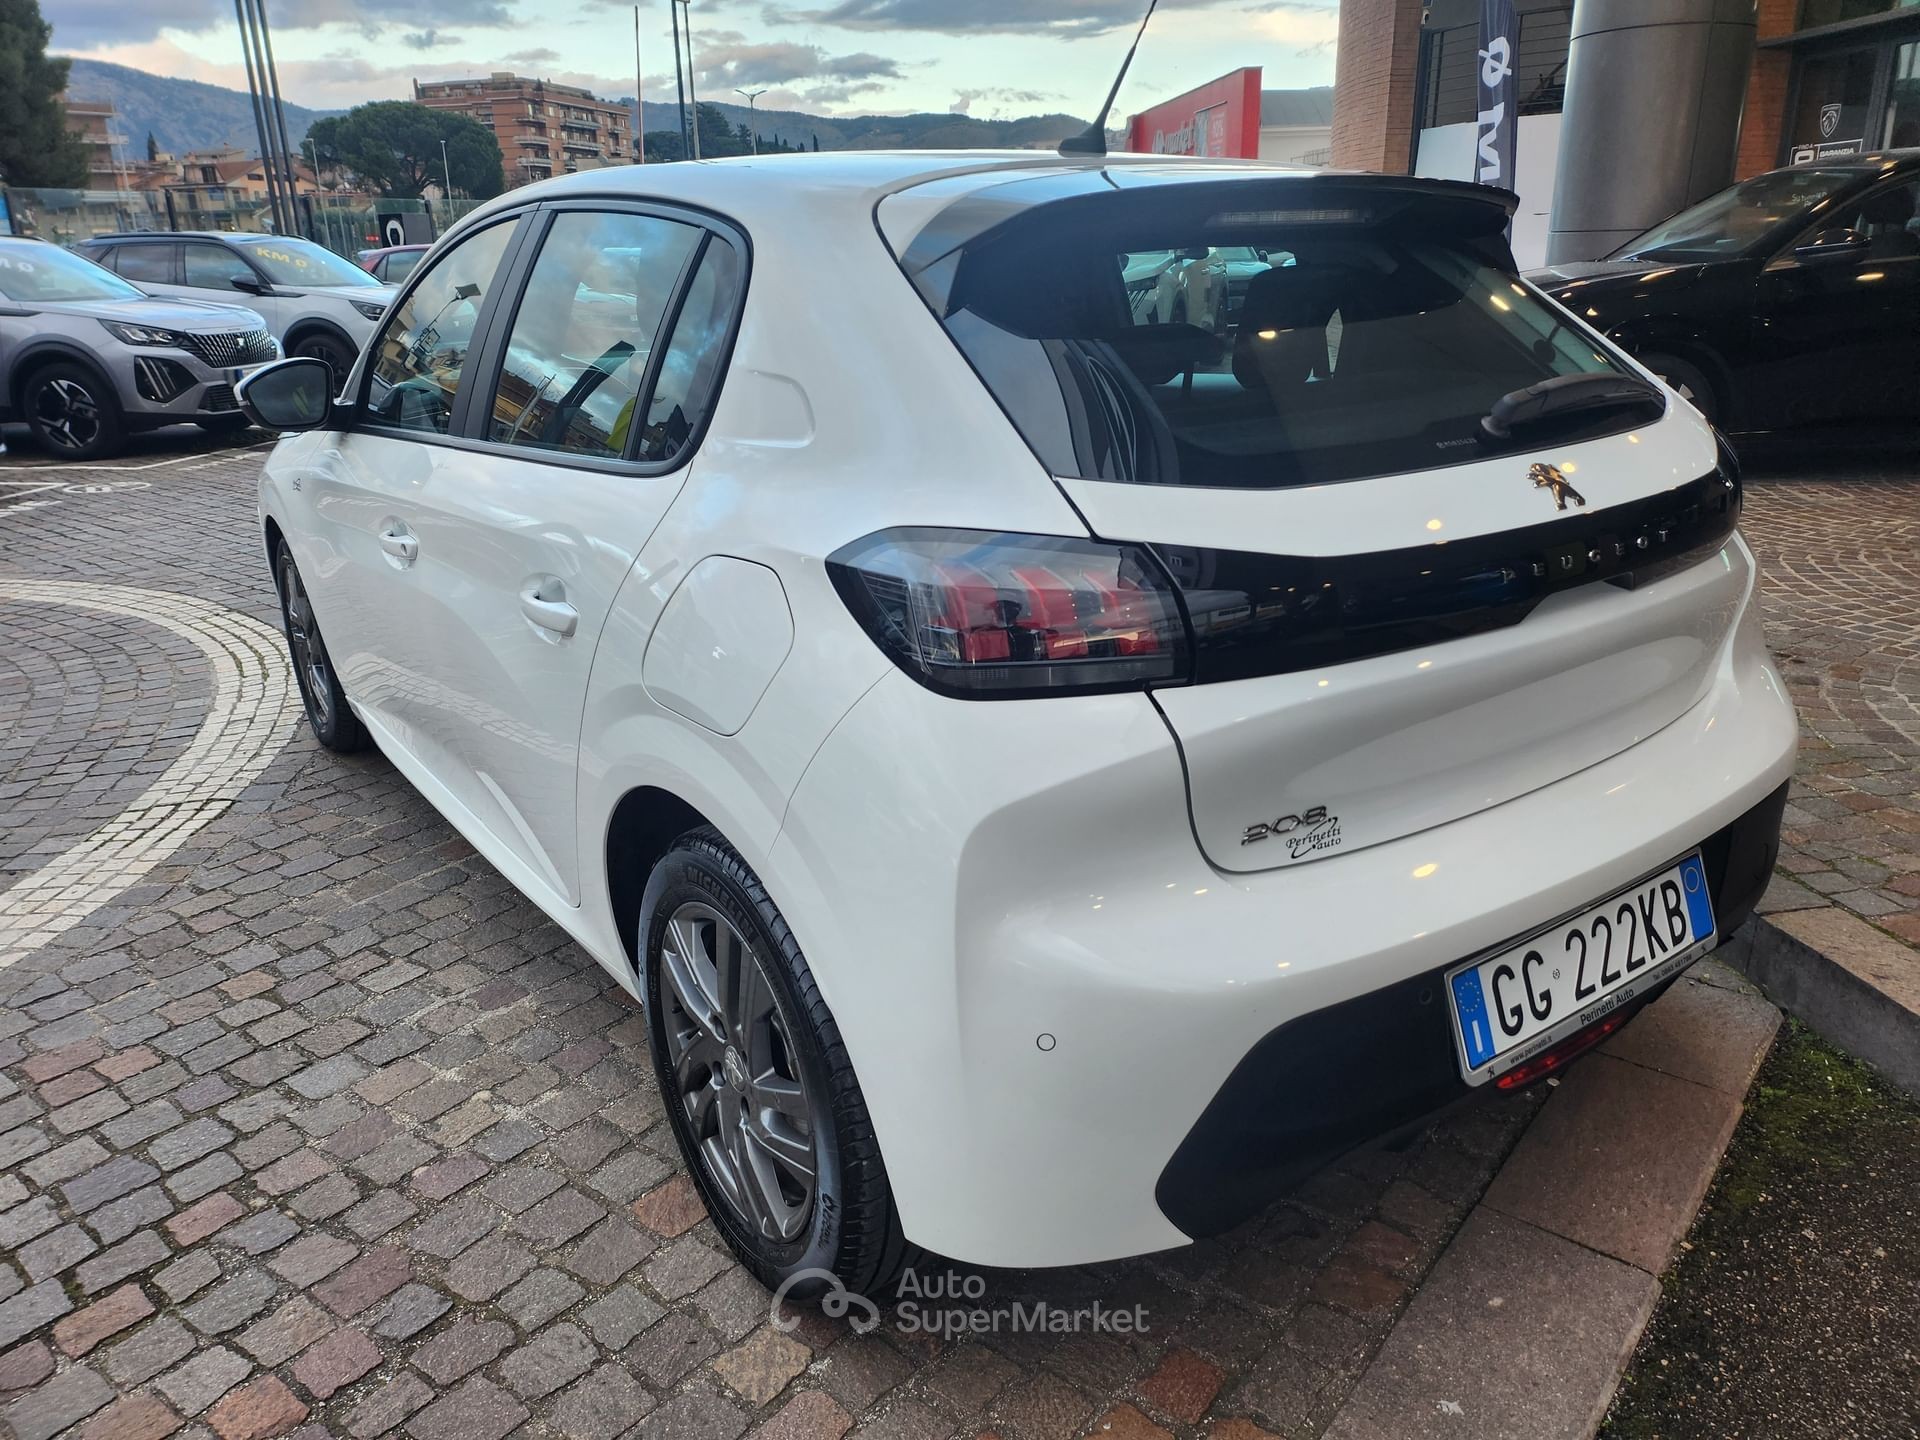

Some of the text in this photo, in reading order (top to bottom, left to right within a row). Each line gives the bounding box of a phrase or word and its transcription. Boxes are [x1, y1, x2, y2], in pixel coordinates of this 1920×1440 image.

[1819, 147, 1855, 158] GARANZIA
[1501, 529, 1669, 584] PEUGEOT
[1241, 805, 1327, 846] 208
[1286, 825, 1342, 849] Perinetti
[1317, 837, 1342, 850] auto
[686, 865, 753, 940] MICHELIN
[1491, 879, 1687, 1037] GG 222KB
[1579, 988, 1635, 1026] Perinetti Auto
